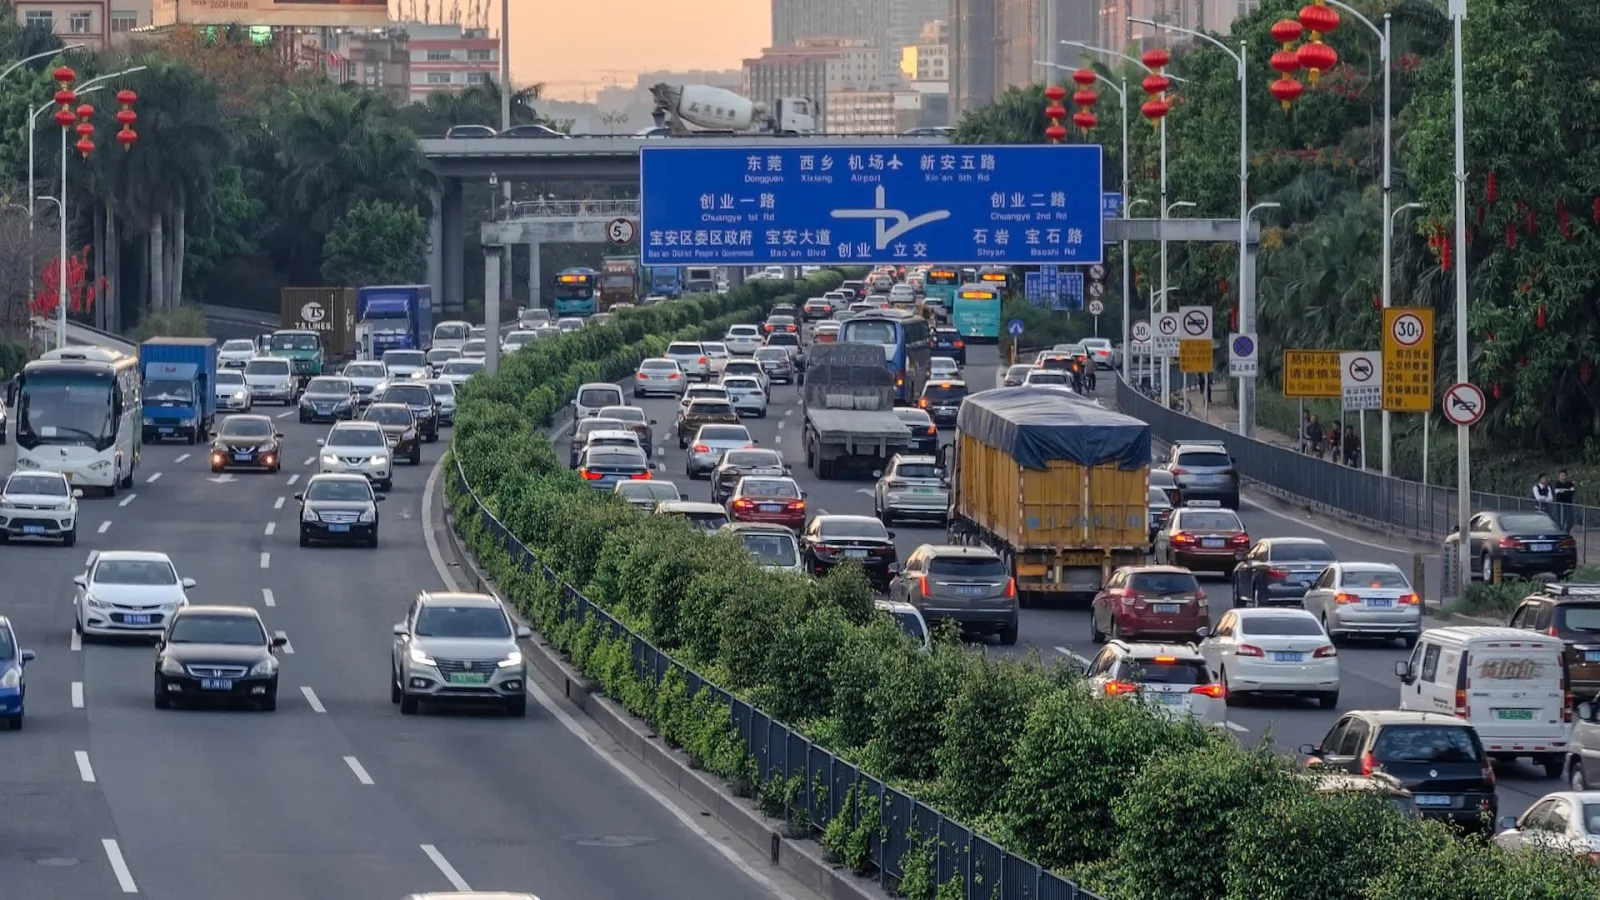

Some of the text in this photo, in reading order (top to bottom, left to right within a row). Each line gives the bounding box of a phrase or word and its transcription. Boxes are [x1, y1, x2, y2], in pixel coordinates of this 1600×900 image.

[746, 154, 996, 172] 东莞 西乡 机场 新安五路
[744, 173, 990, 184] Dongguan Xixiang Airport Xin'an 5th Rd
[700, 193, 776, 209] 创业一路
[991, 191, 1066, 208] 创业二路
[701, 213, 775, 223] Chuangye 1st Rd
[990, 212, 1067, 222] Chuangye 2nd Rd
[650, 229, 831, 246] 宝安区委区政府 宝安大道
[973, 228, 1083, 245] 石岩 宝石路
[770, 249, 827, 257] Bao'an Blvd
[837, 242, 928, 258] 创业 立交
[977, 248, 1006, 257] Shiyan
[1030, 248, 1076, 256] Baoshi Rd
